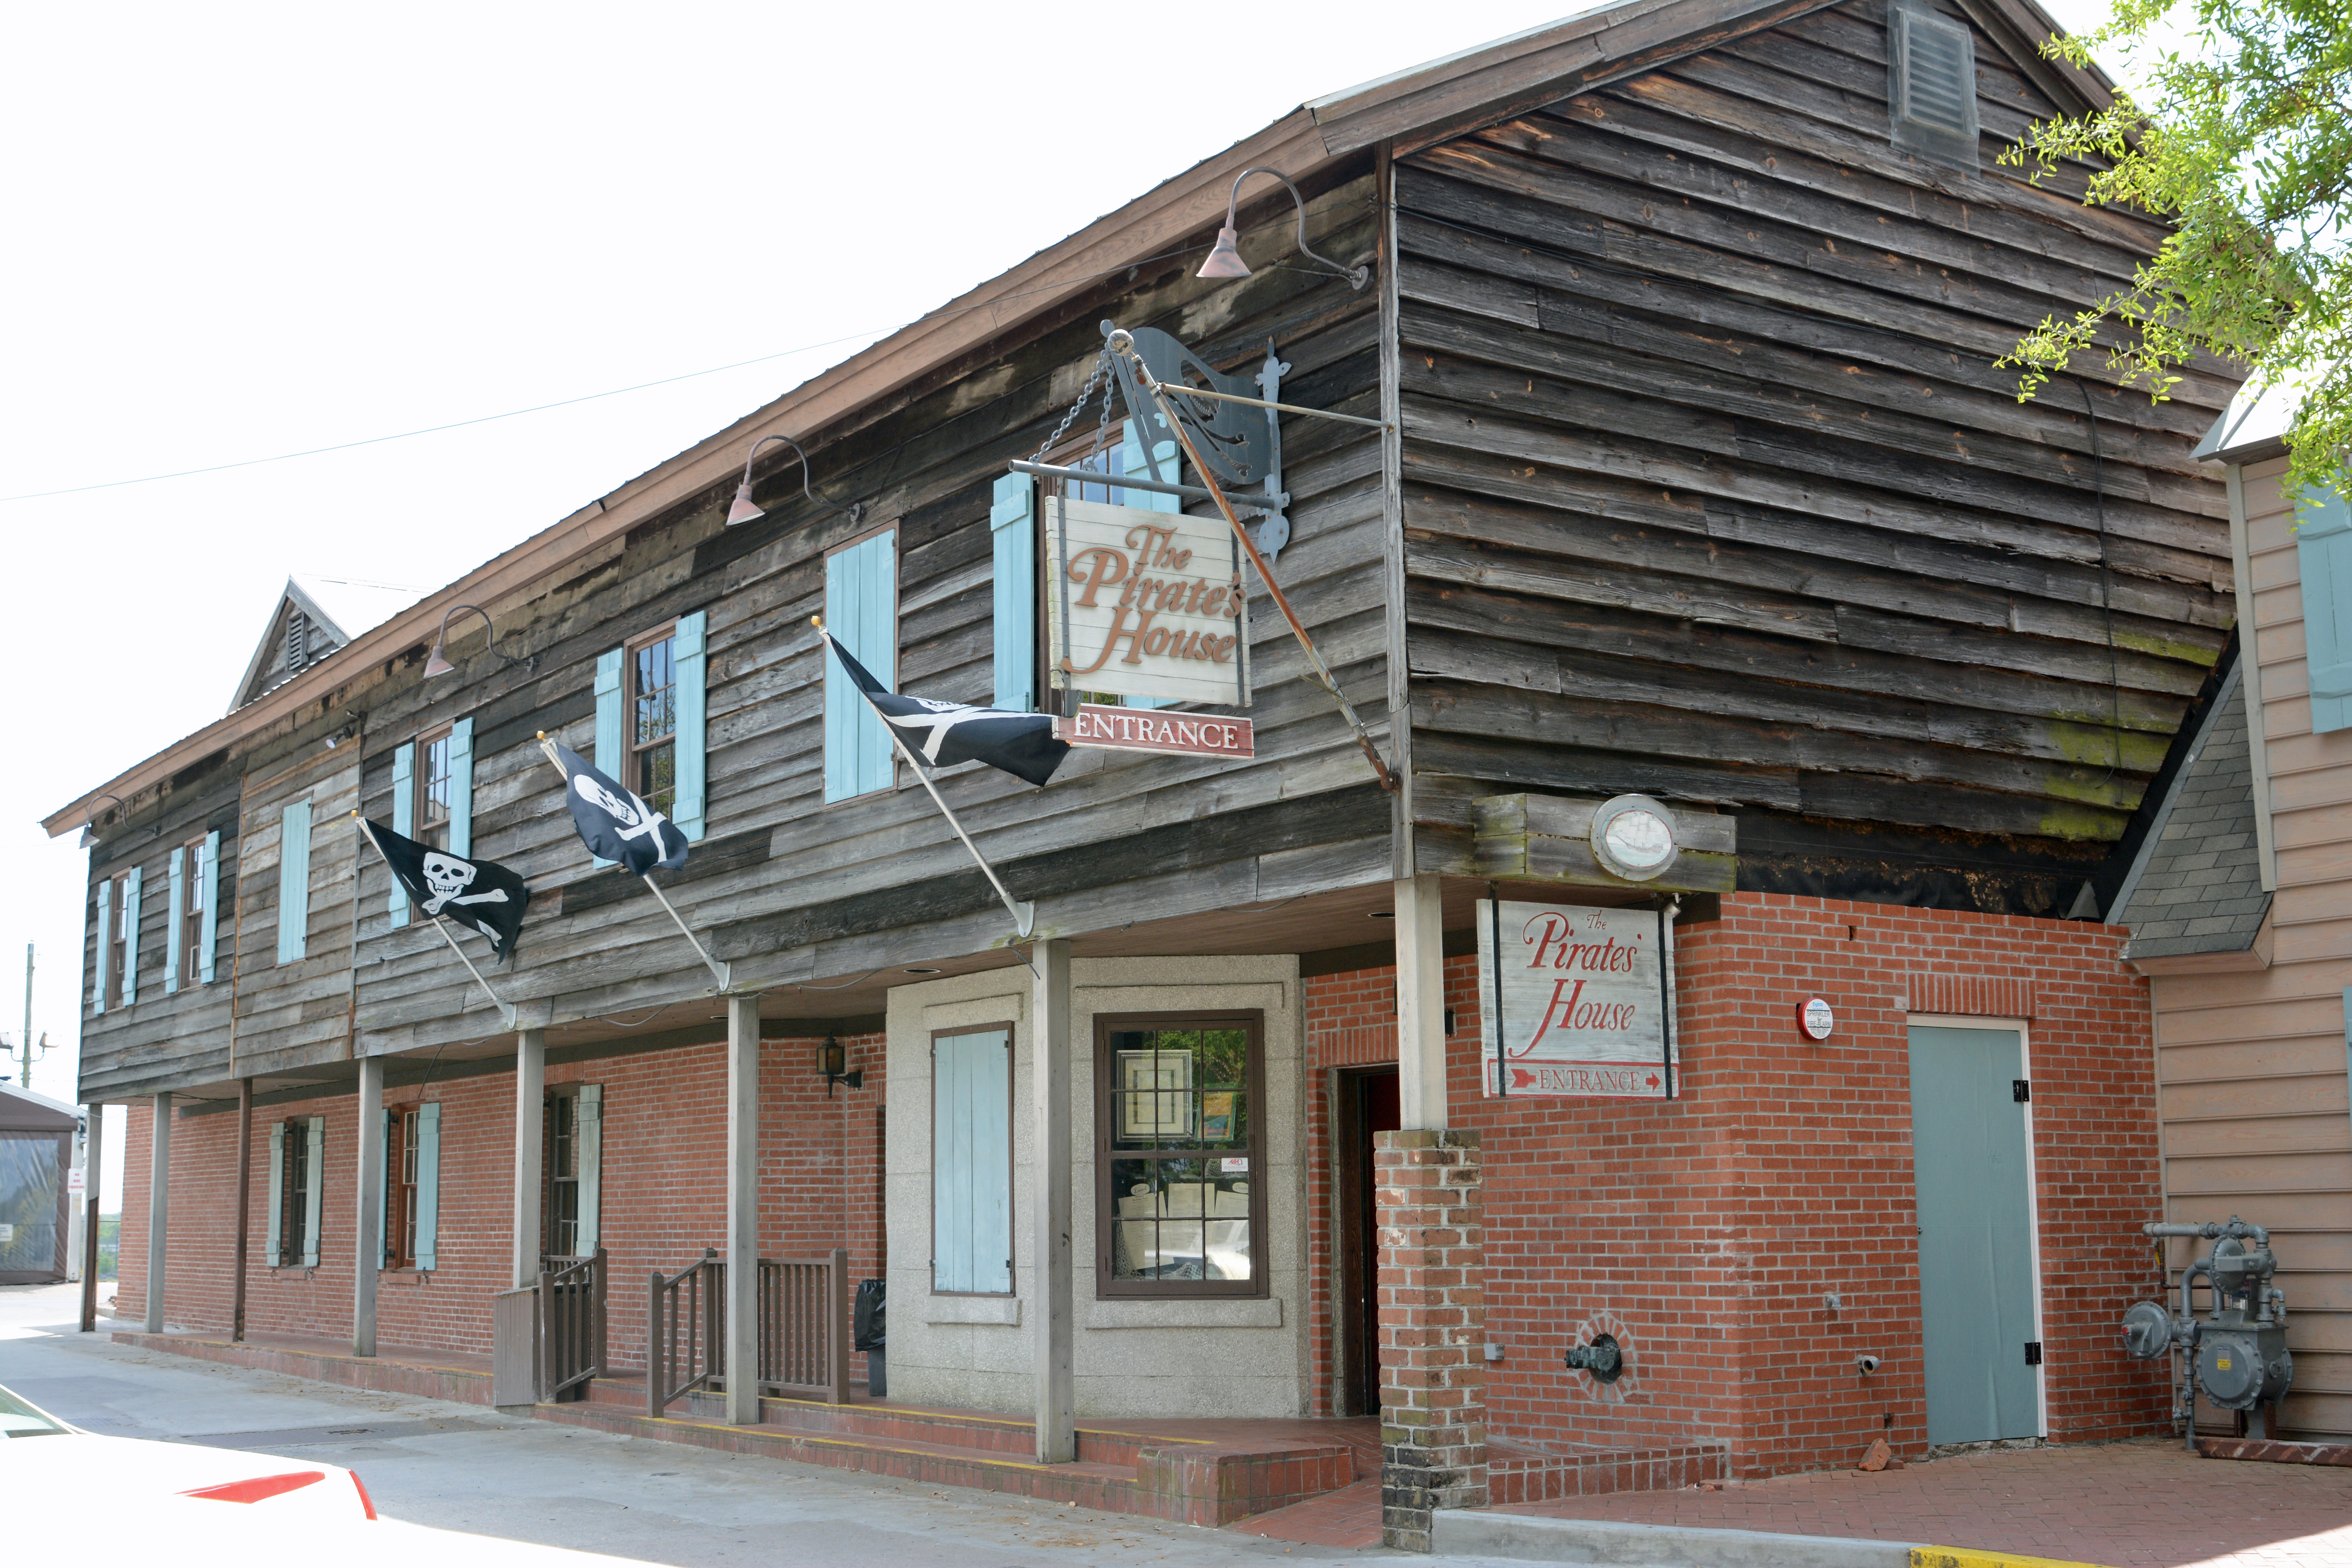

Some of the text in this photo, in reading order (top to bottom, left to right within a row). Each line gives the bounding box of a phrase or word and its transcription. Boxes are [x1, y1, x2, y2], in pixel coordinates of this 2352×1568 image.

[1125, 524, 1192, 569] The
[1067, 547, 1246, 617] Pirate's
[1061, 606, 1236, 674] House
[1074, 712, 1238, 750] ENTRANCE
[1587, 910, 1606, 931] The
[1508, 978, 1635, 1058] House
[1539, 1069, 1641, 1091] ENTRANCE
